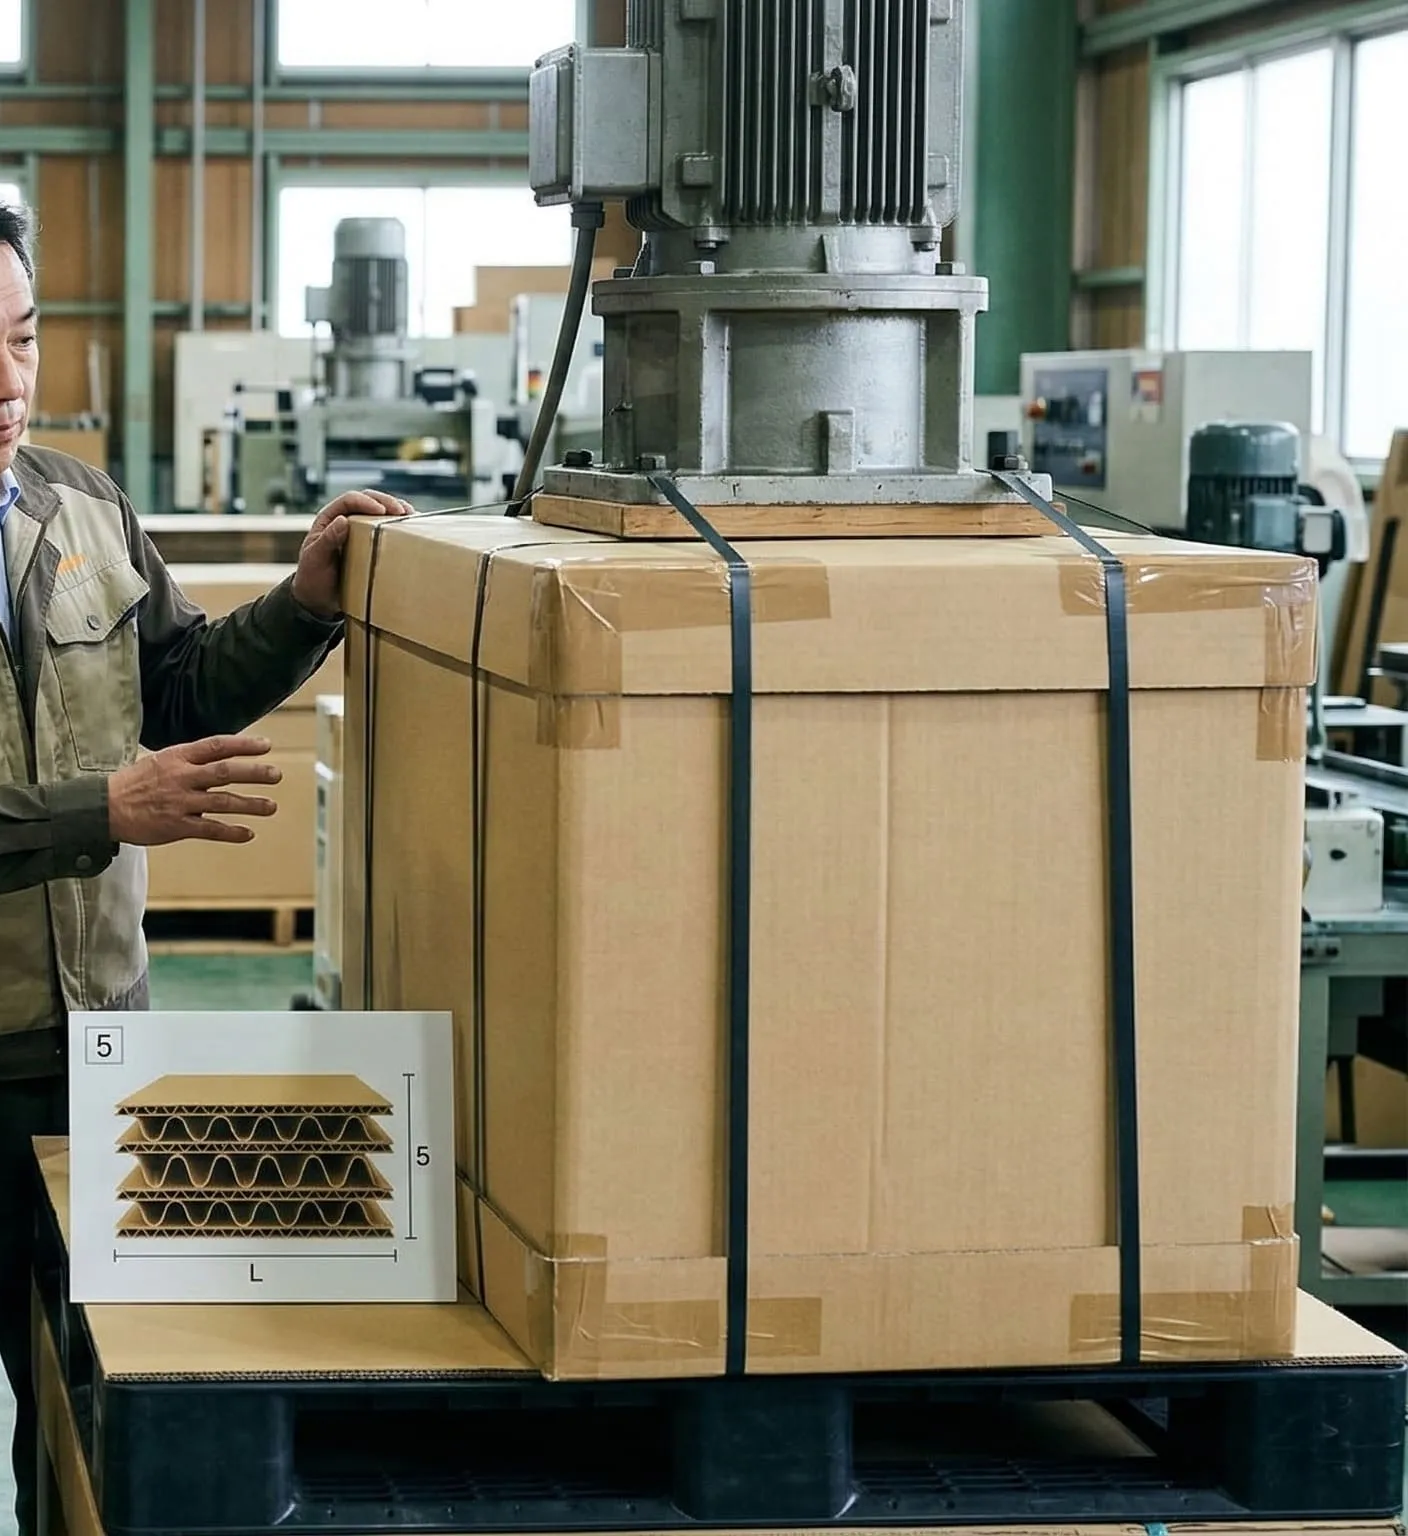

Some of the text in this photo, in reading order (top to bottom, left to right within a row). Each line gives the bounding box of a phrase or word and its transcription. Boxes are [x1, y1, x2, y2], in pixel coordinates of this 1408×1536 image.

[96, 1034, 113, 1058] 5
[416, 1145, 431, 1167] 5
[250, 1263, 263, 1283] L
